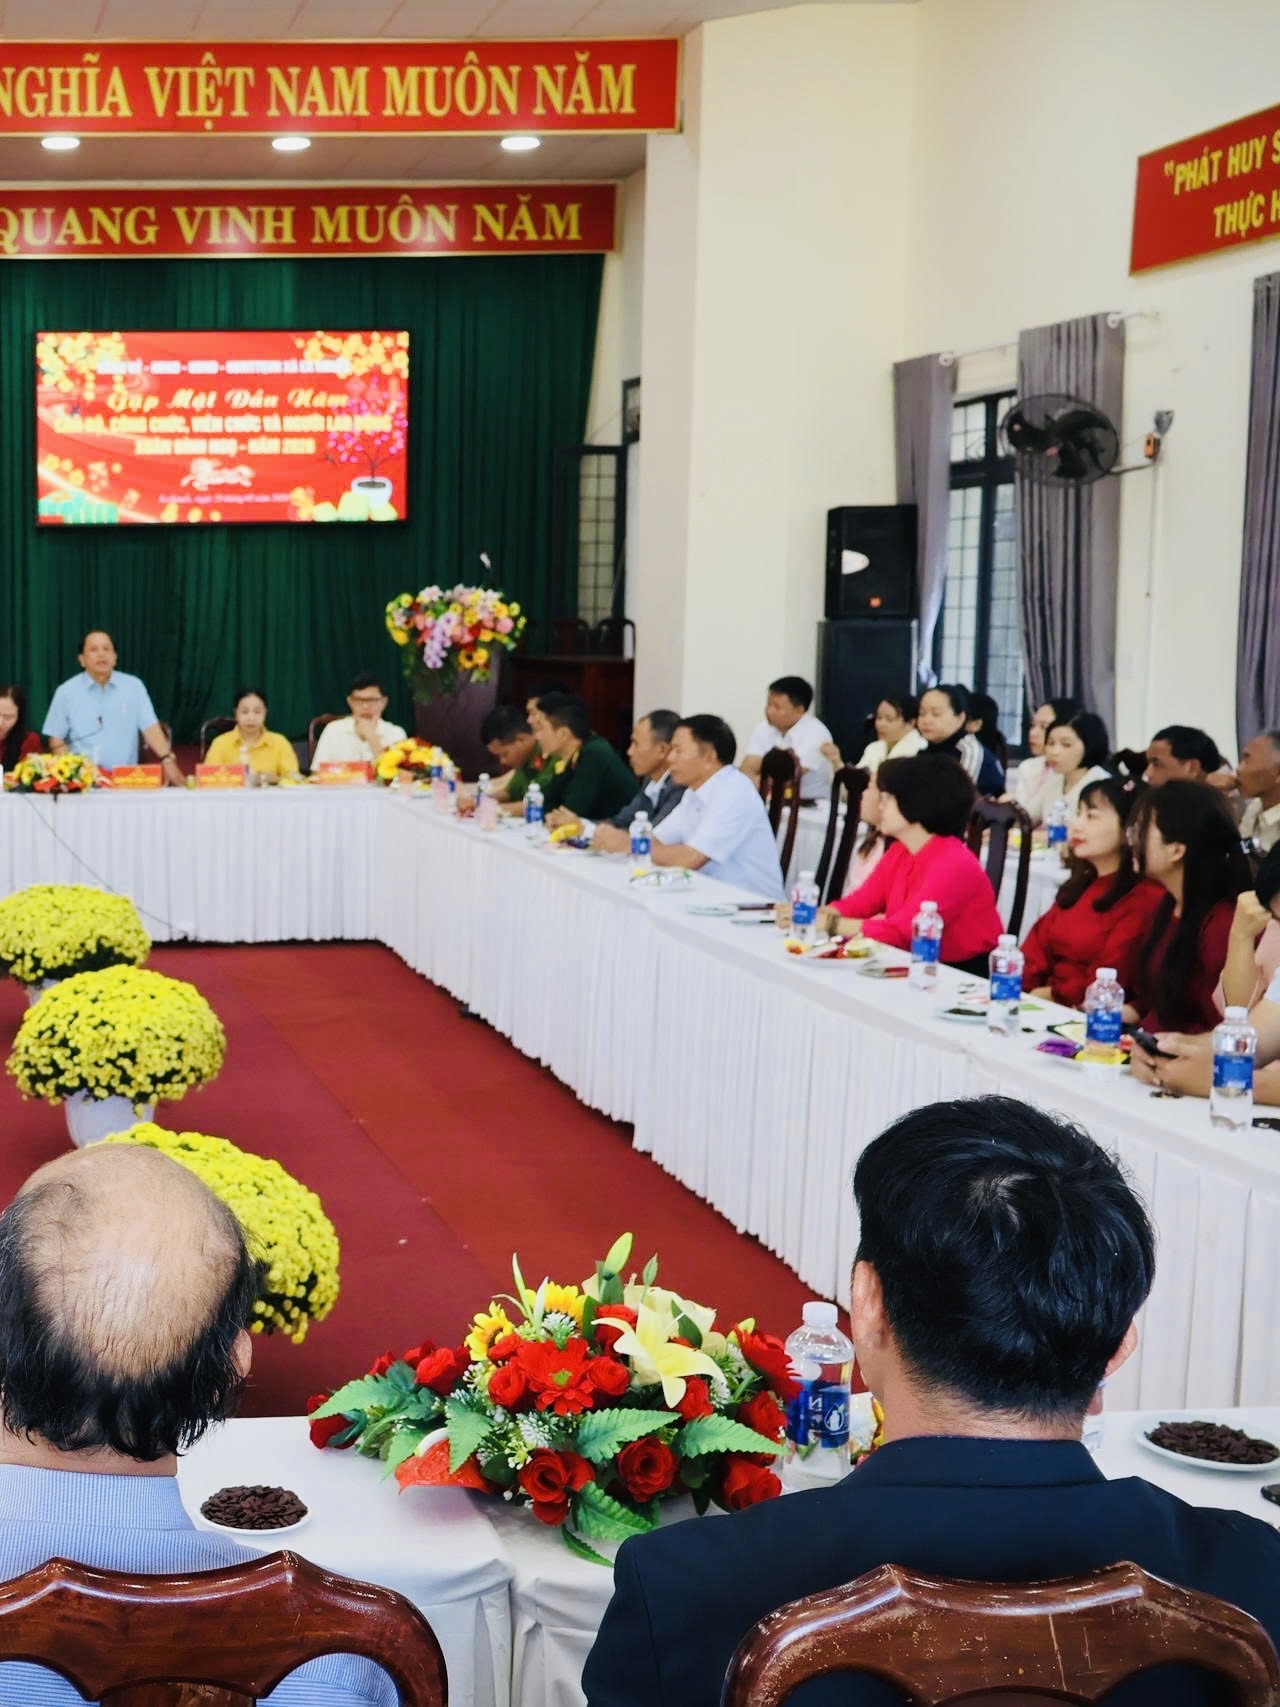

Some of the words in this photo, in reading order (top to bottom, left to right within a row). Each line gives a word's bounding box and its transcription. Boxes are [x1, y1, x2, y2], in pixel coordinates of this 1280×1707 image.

[144, 52, 256, 131] VIỆT
[266, 66, 370, 117] NAM
[382, 51, 520, 116] MUÔN
[532, 52, 638, 115] NĂM
[1226, 135, 1267, 178] HUY
[172, 206, 297, 246] VINH
[311, 195, 459, 245] MUÔN
[472, 194, 582, 241] NĂM
[1213, 190, 1266, 238] THỰC
